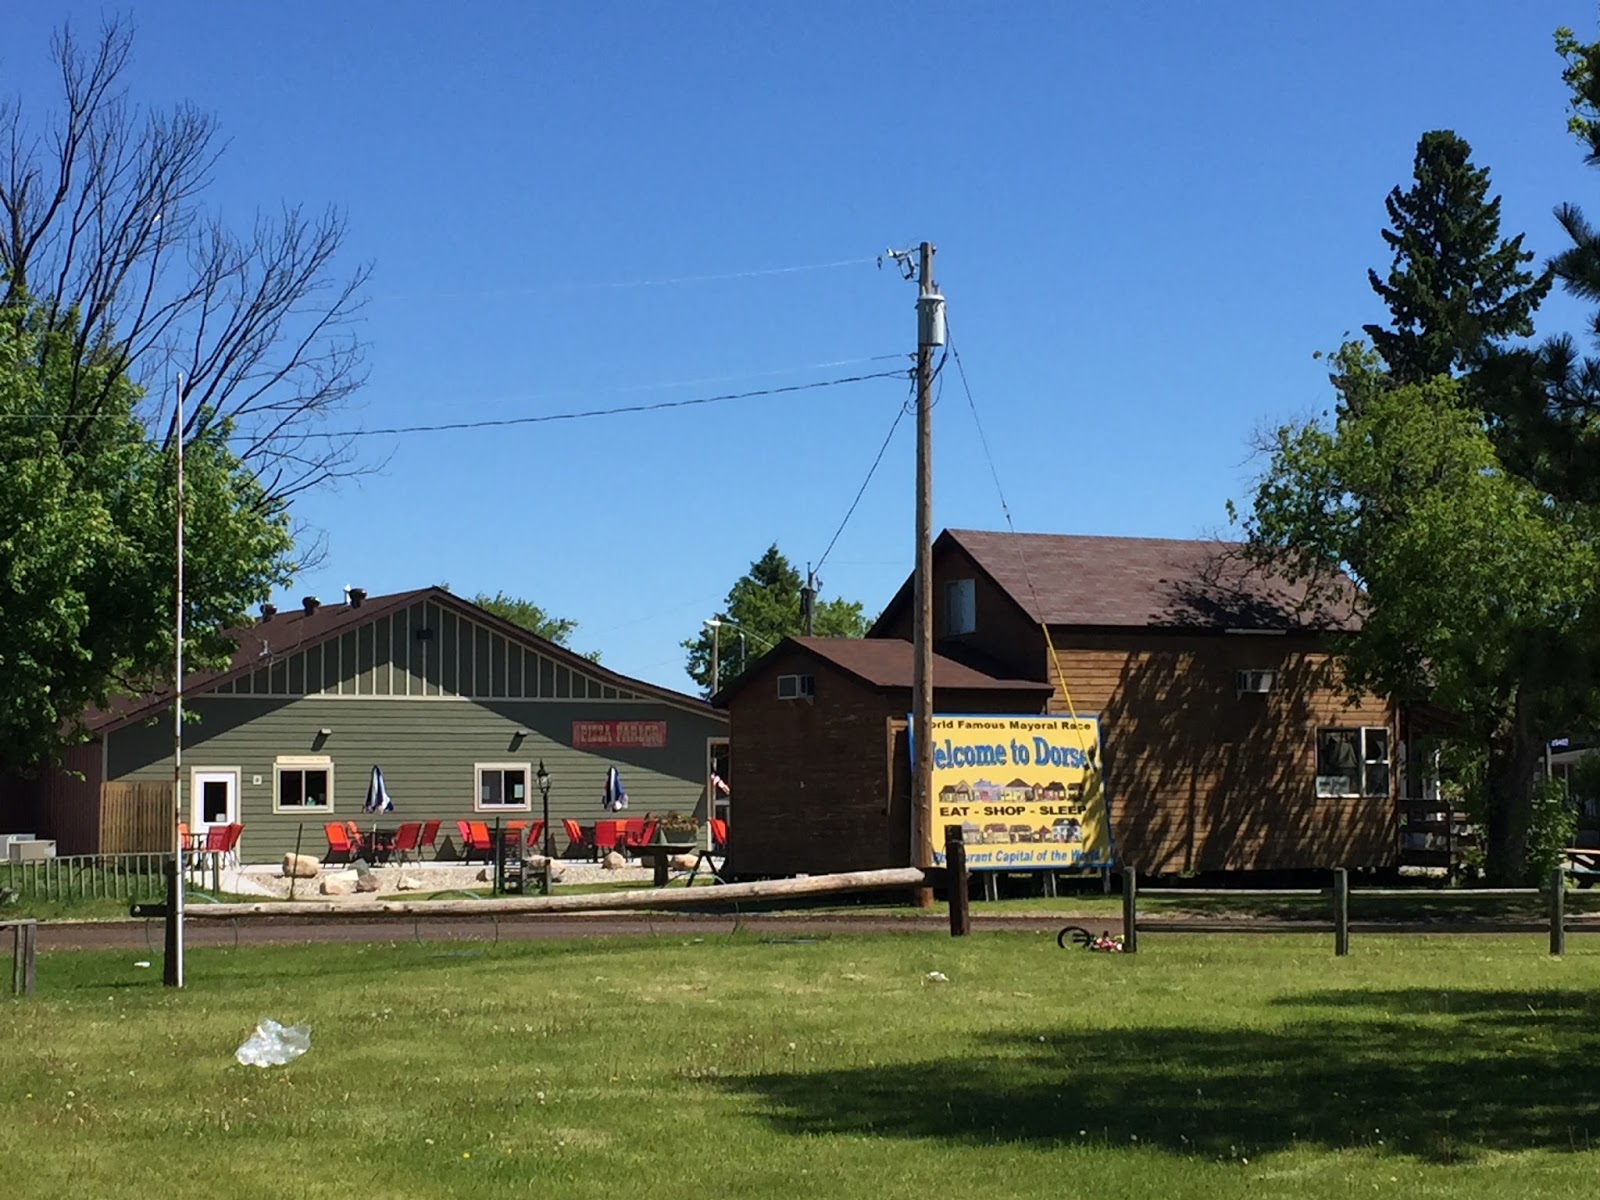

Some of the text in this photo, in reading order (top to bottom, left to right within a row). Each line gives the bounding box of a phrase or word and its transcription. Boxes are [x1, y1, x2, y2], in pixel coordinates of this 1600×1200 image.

[931, 720, 1091, 731] orld Famous Mayoral Race
[931, 736, 1096, 770] elcome to Dorse
[940, 806, 970, 816] EAT
[983, 806, 1026, 816] SHOP
[1039, 805, 1087, 816] SLEEP
[995, 850, 1034, 865] Capital
[1036, 850, 1048, 861] of
[1051, 850, 1067, 861] the
